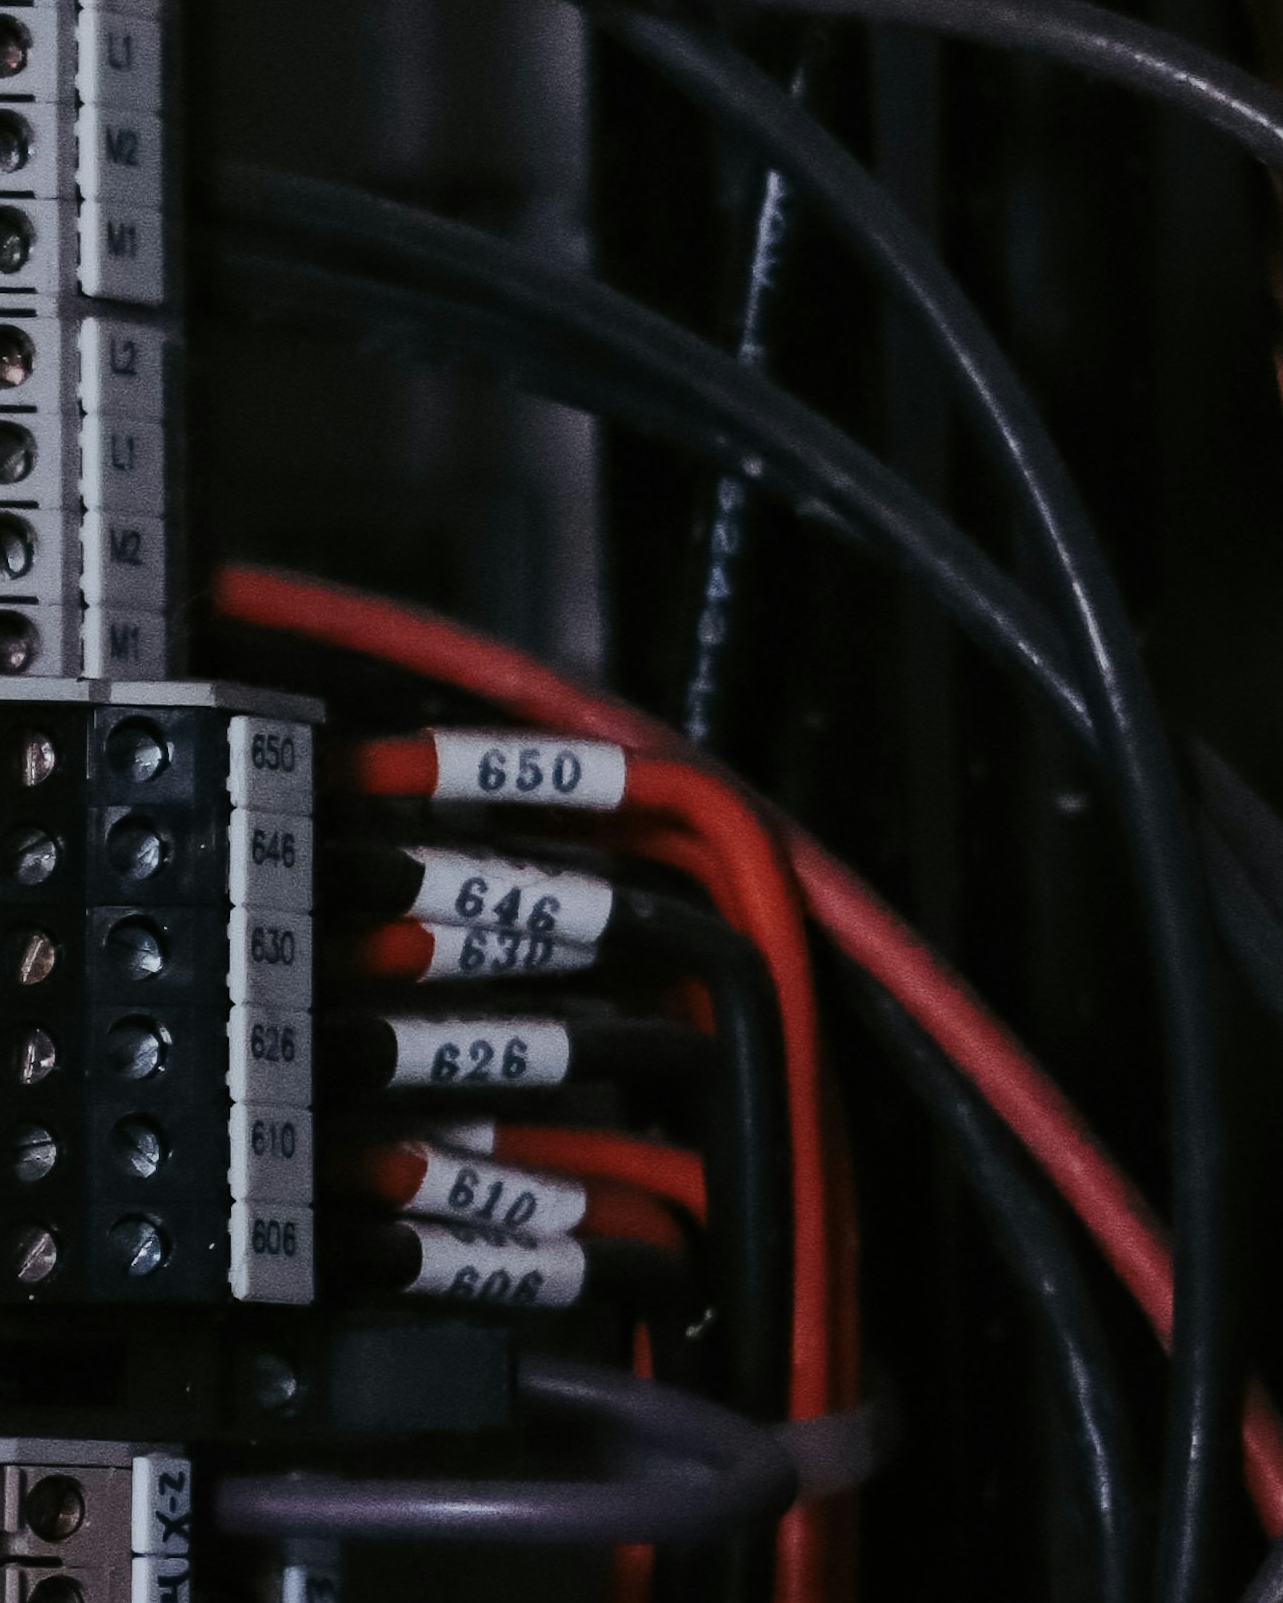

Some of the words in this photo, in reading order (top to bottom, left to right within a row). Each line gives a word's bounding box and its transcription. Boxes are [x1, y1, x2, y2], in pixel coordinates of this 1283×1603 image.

[106, 126, 138, 166] M2
[109, 338, 137, 375] L2
[251, 733, 295, 773] 650
[478, 747, 582, 794] 650
[251, 829, 295, 869] 646
[456, 875, 561, 936] 646
[251, 927, 295, 968] 630
[250, 1024, 295, 1062] 626
[433, 1036, 529, 1084] 626
[251, 1120, 295, 1160] 610
[448, 1166, 536, 1229] 610
[252, 1219, 296, 1257] 606
